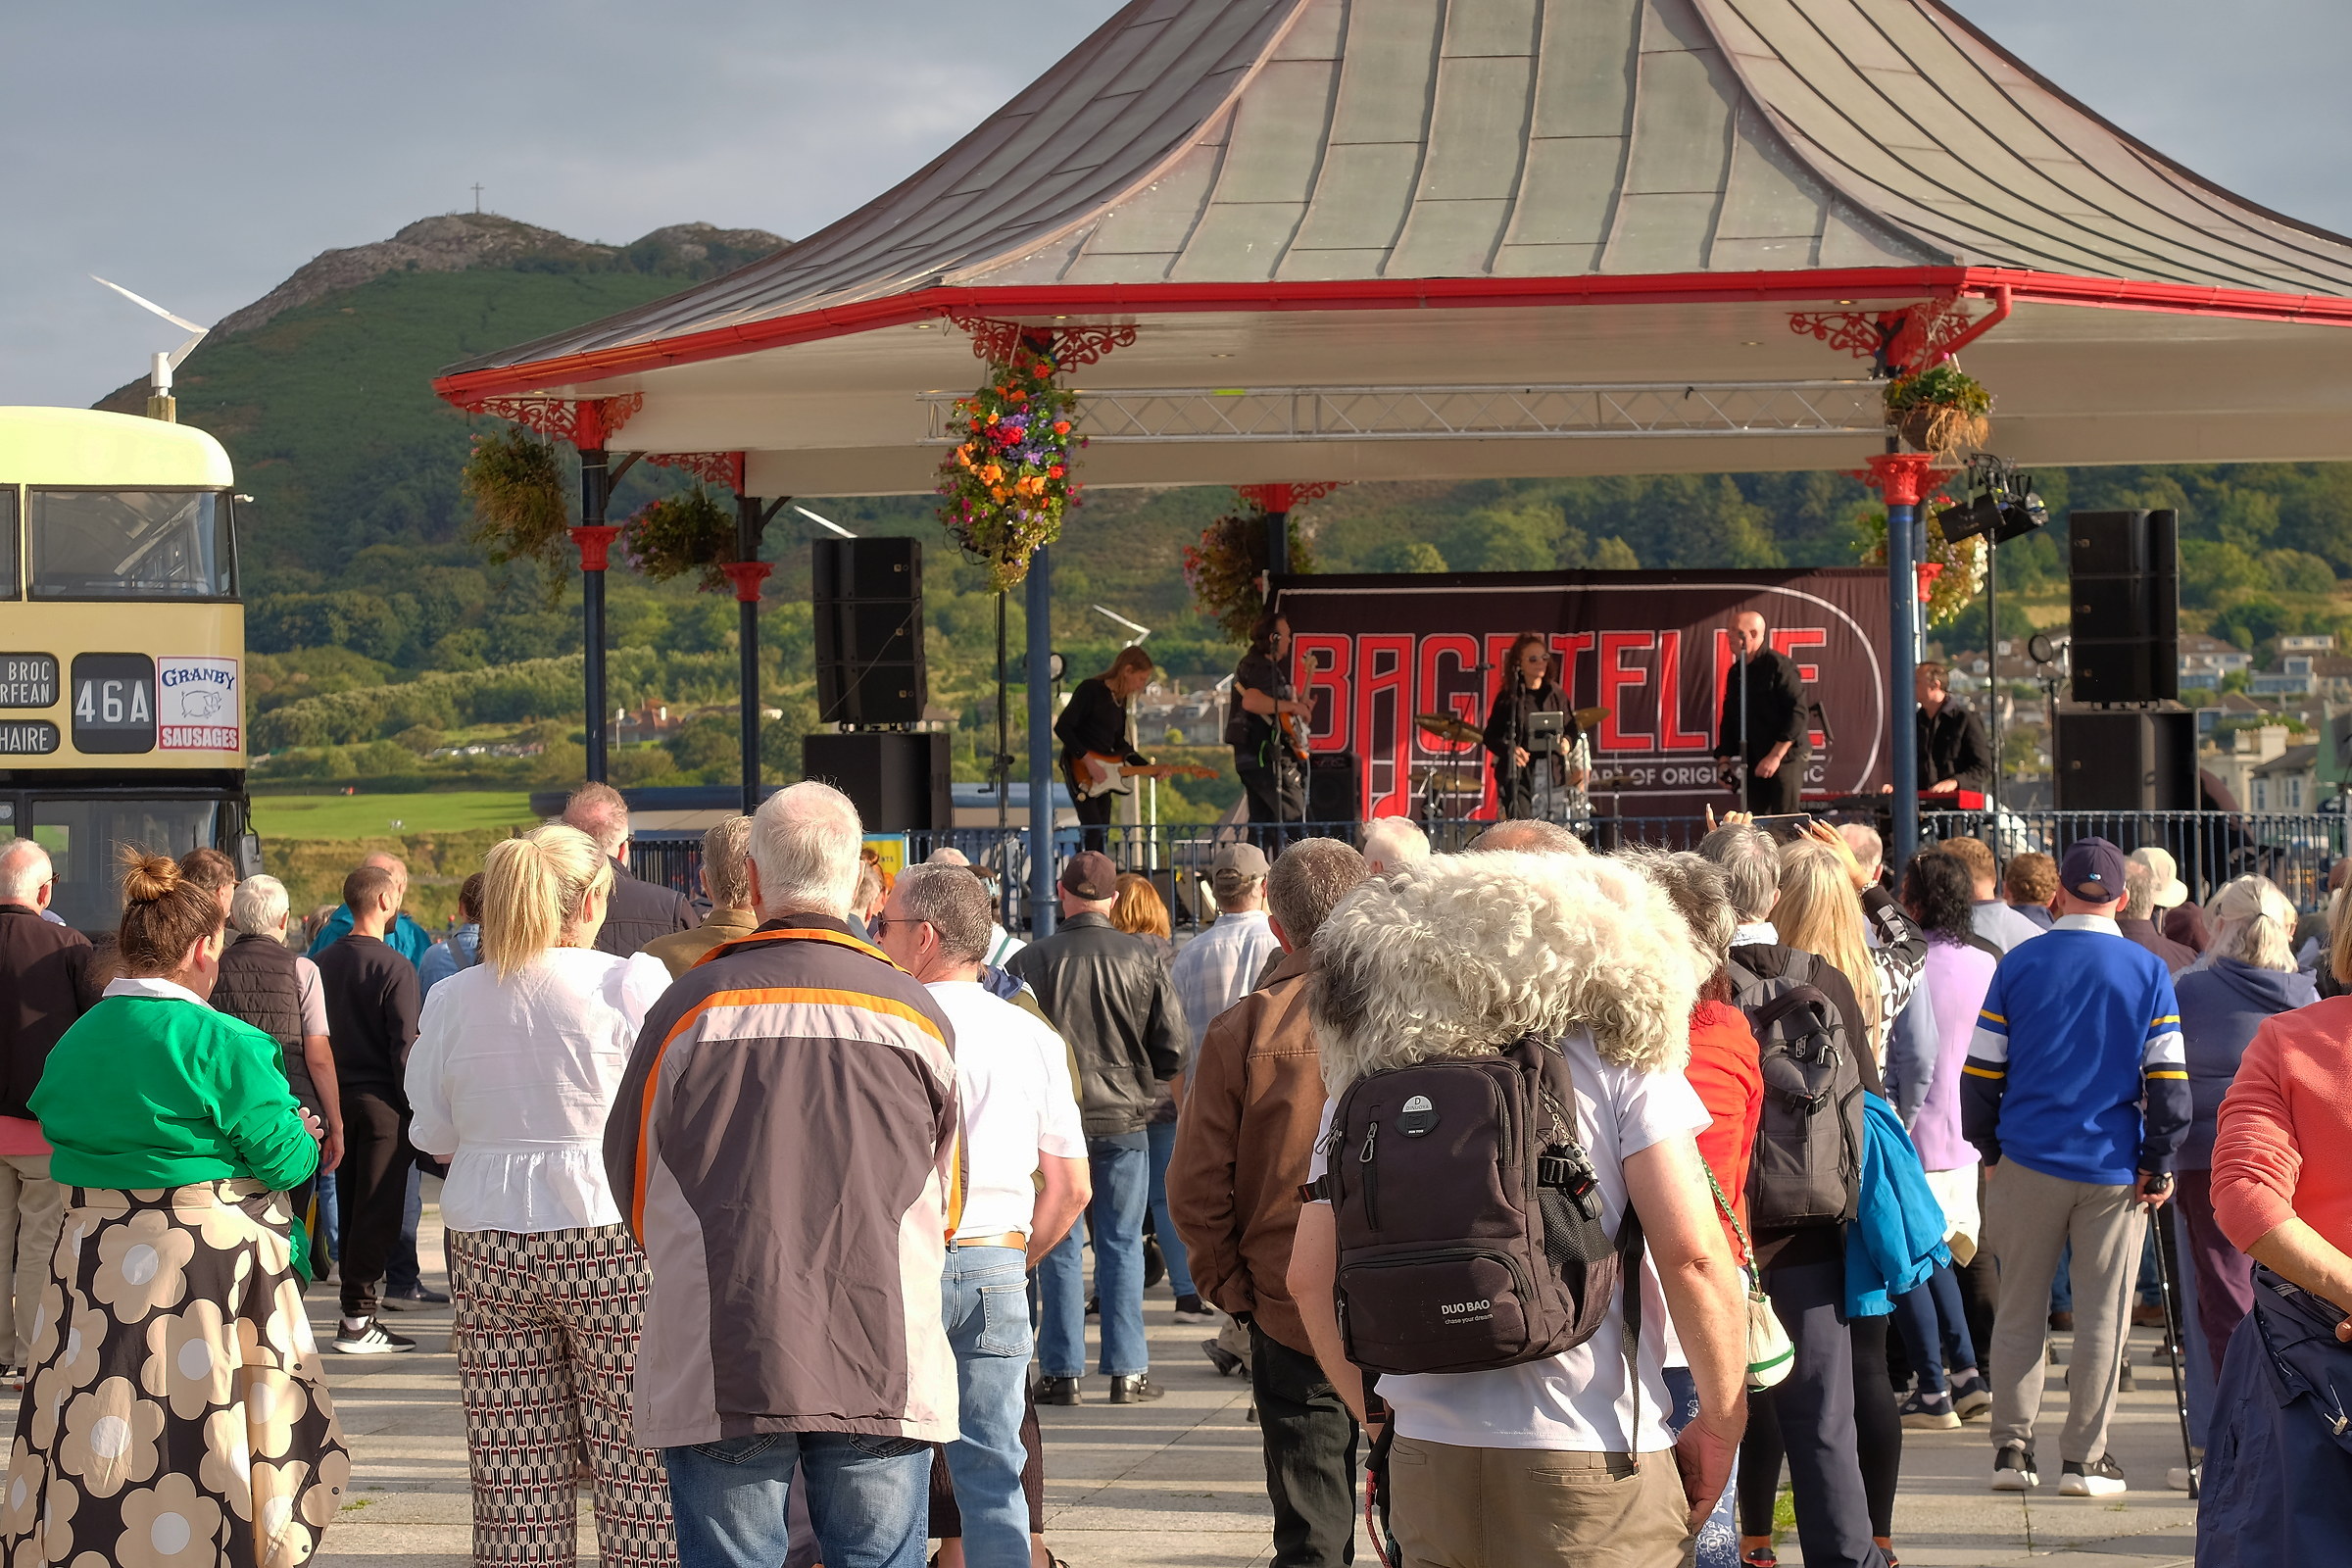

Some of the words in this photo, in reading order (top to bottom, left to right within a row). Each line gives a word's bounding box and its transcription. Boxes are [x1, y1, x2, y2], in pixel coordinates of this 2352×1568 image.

[8, 661, 50, 682] BROC
[162, 667, 235, 691] GRANBY
[0, 683, 50, 704] RFEAN
[75, 680, 150, 723] 46A
[0, 727, 49, 752] HAIRE
[162, 727, 237, 749] SAUSAGES
[1661, 765, 1719, 786] ORIGI
[1441, 1302, 1465, 1315] DUO
[1466, 1298, 1491, 1312] BAO
